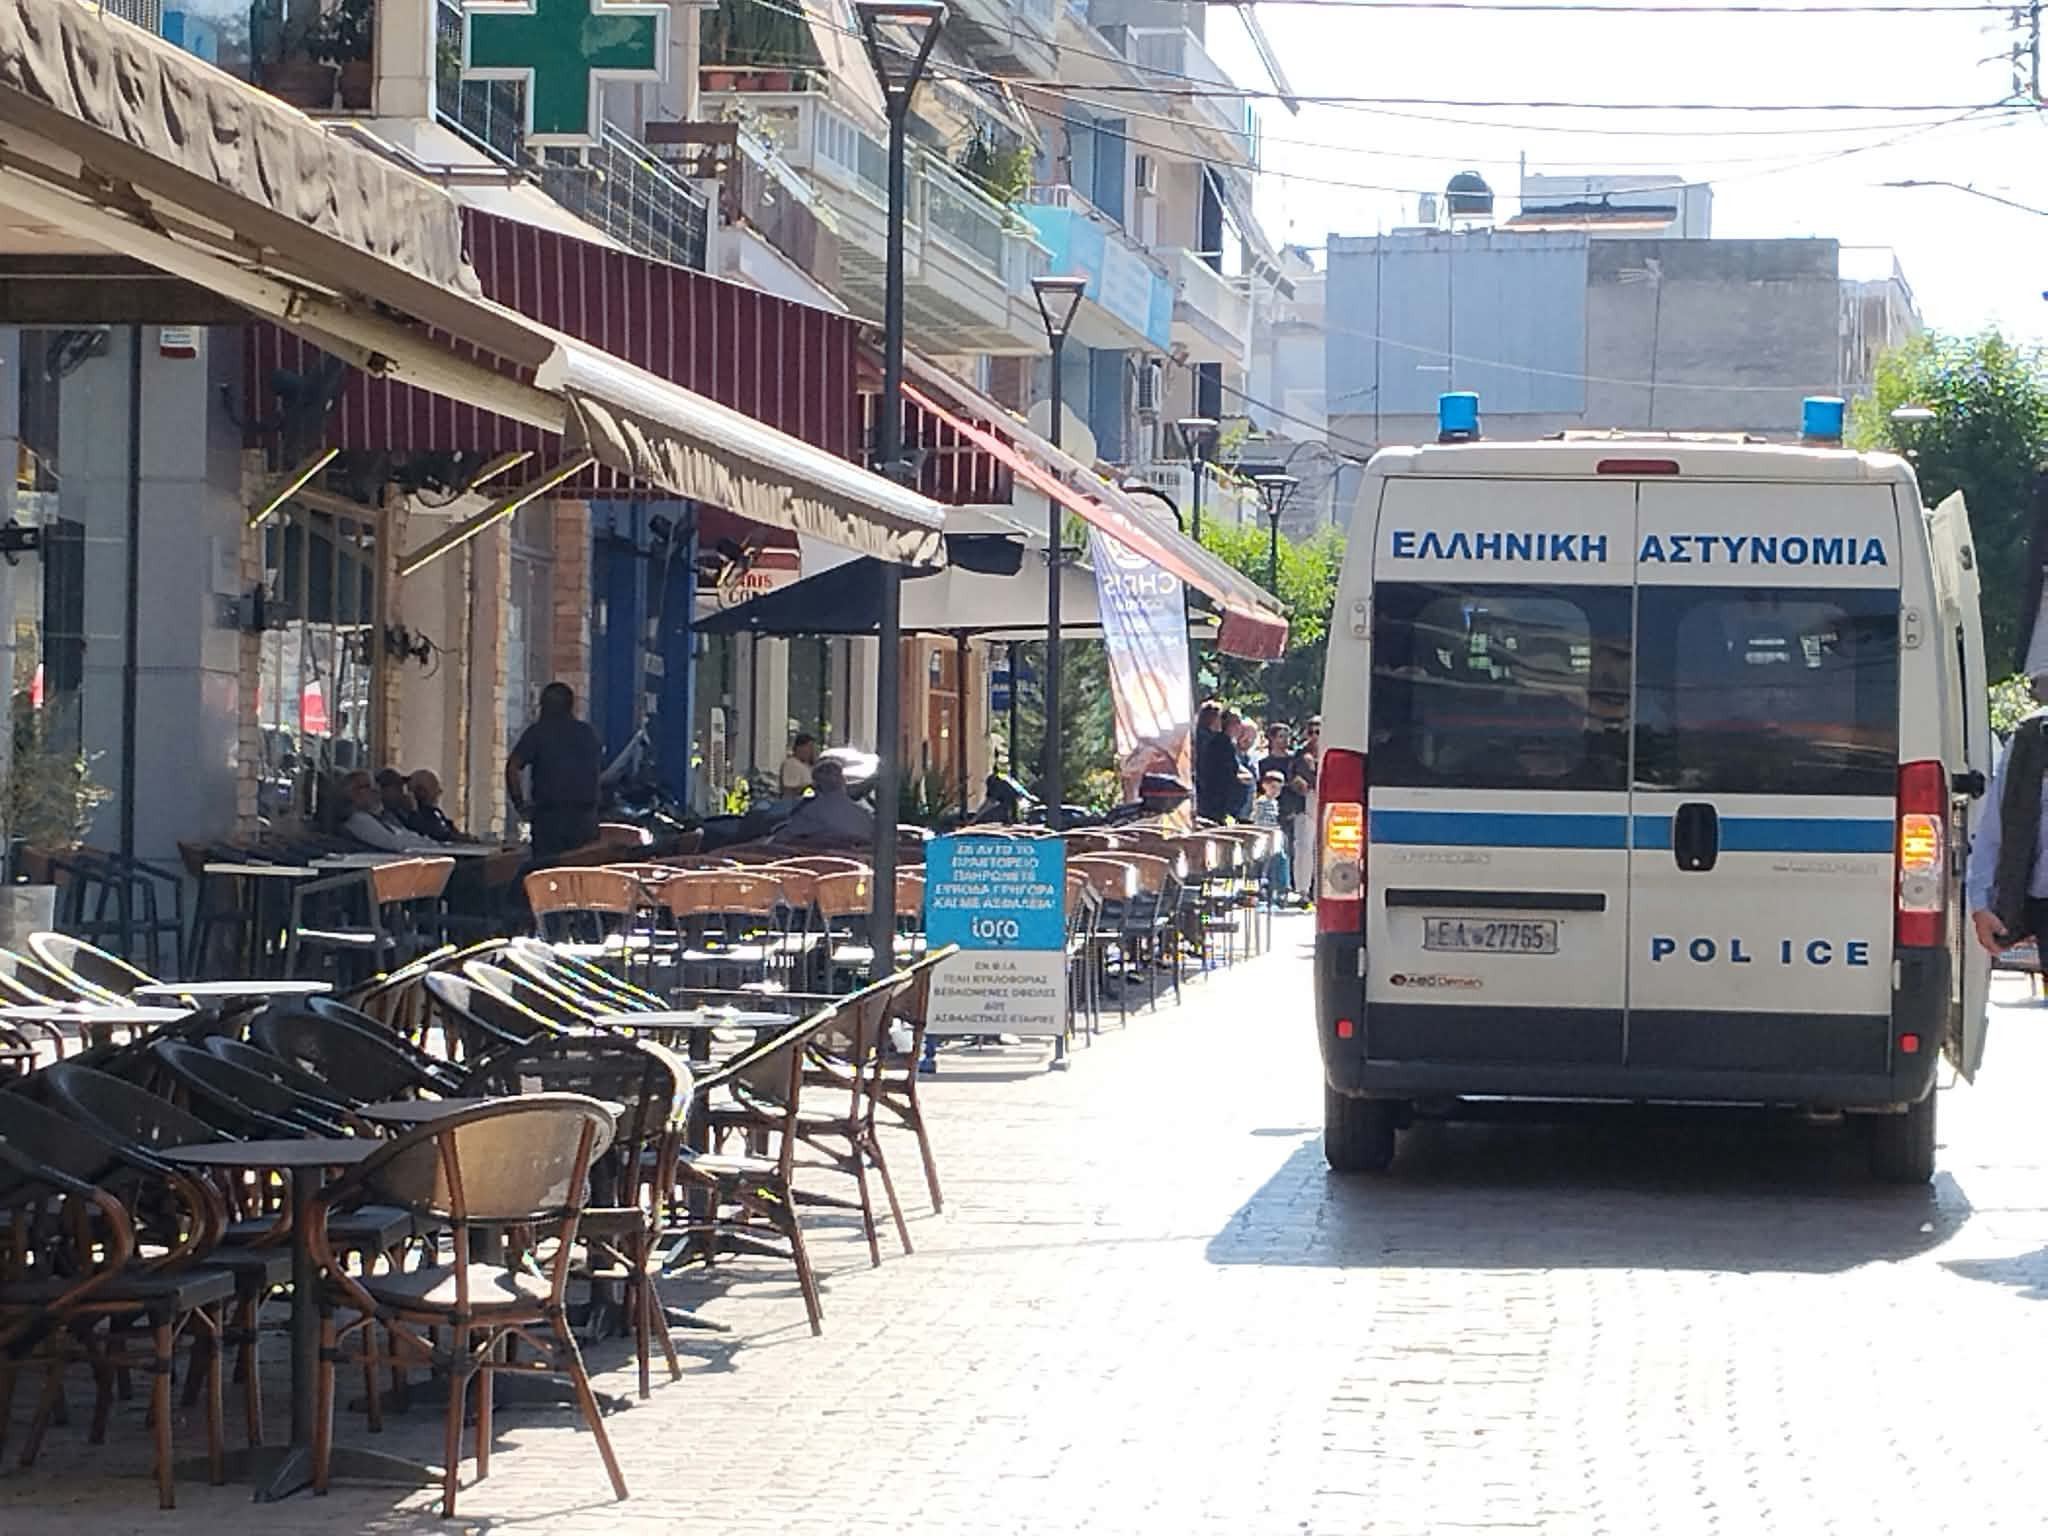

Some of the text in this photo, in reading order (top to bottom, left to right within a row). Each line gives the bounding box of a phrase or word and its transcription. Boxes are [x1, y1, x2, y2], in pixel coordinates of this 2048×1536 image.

[1393, 531, 1888, 566] ΕΛΛΗΝΙΚΗ ΑΣΤΥΝΟΜΙΑ
[1017, 845, 1035, 855] ΤΟ
[1485, 923, 1544, 949] 27765
[1652, 937, 1870, 966] POLICE
